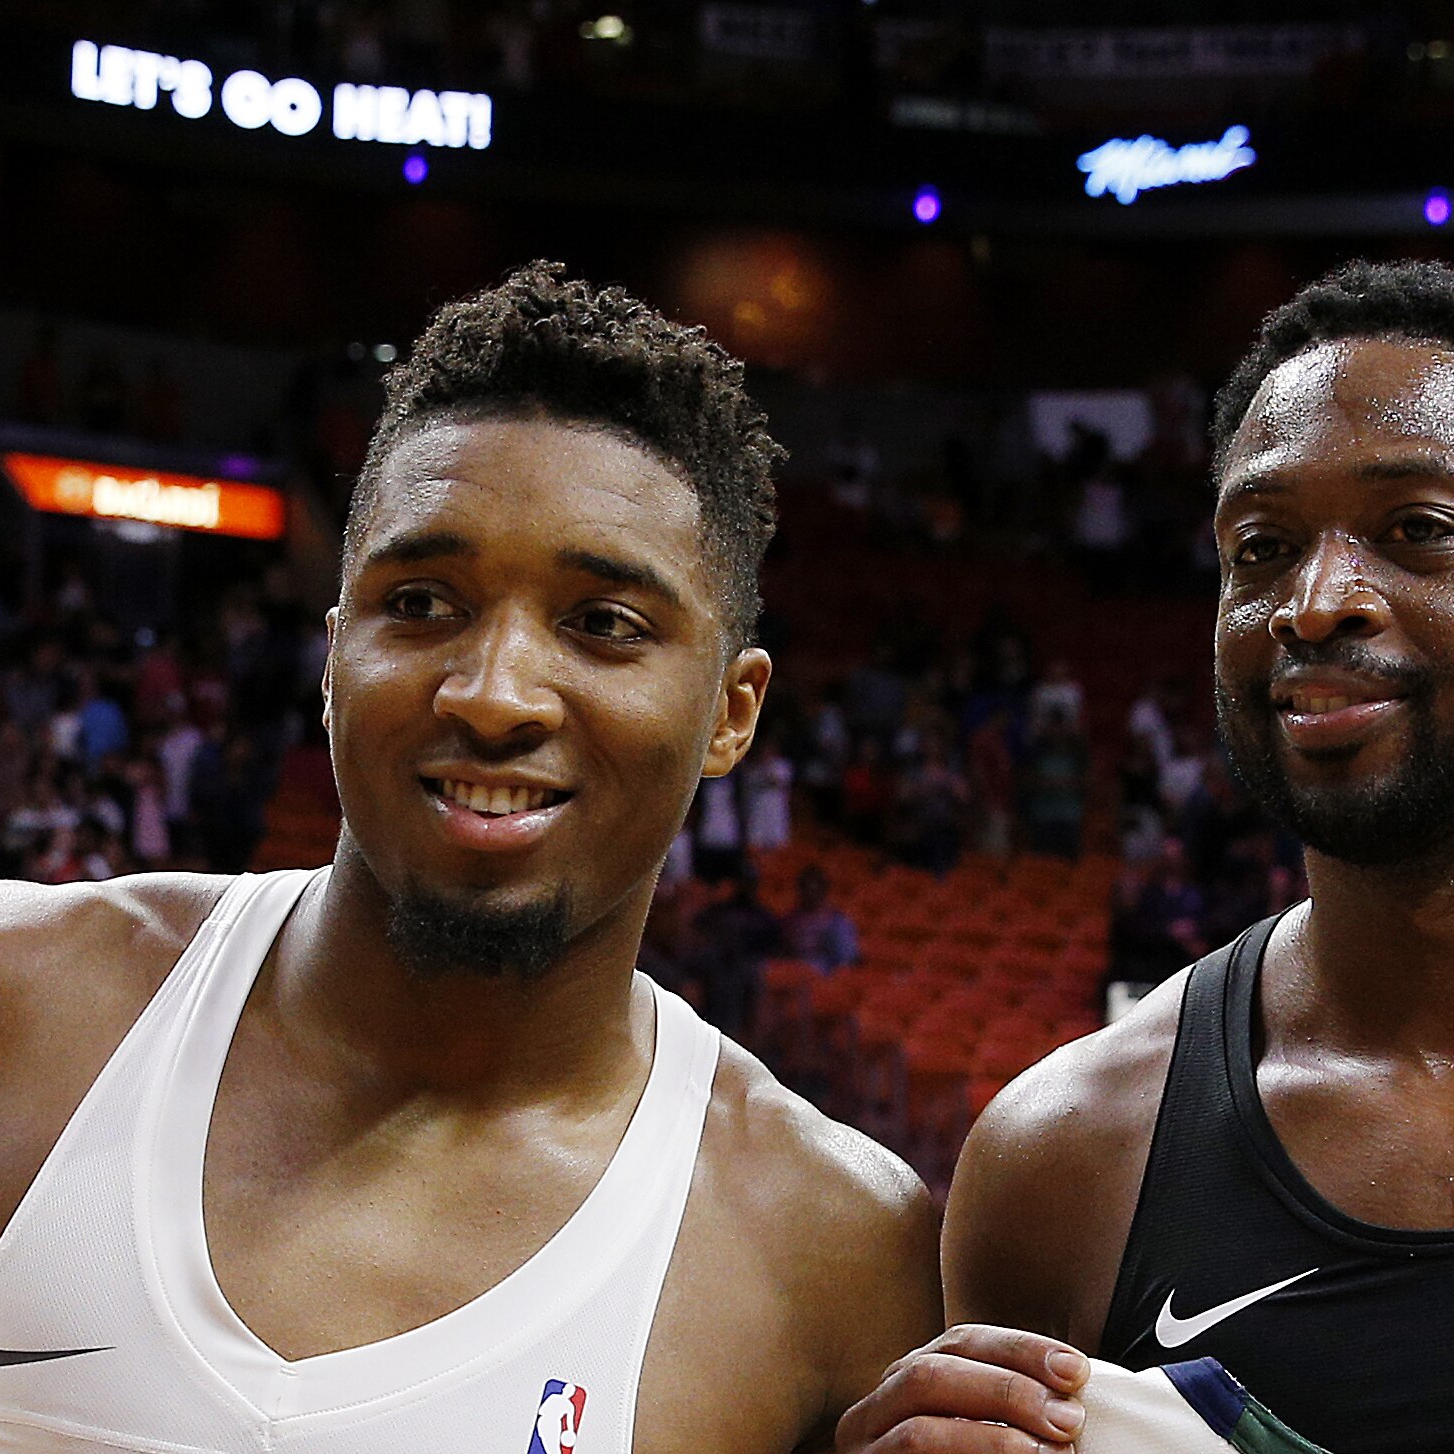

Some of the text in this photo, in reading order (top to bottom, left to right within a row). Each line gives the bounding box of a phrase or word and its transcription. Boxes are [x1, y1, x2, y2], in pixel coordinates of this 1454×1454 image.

[72, 40, 492, 149] LET'S GO HEAT!
